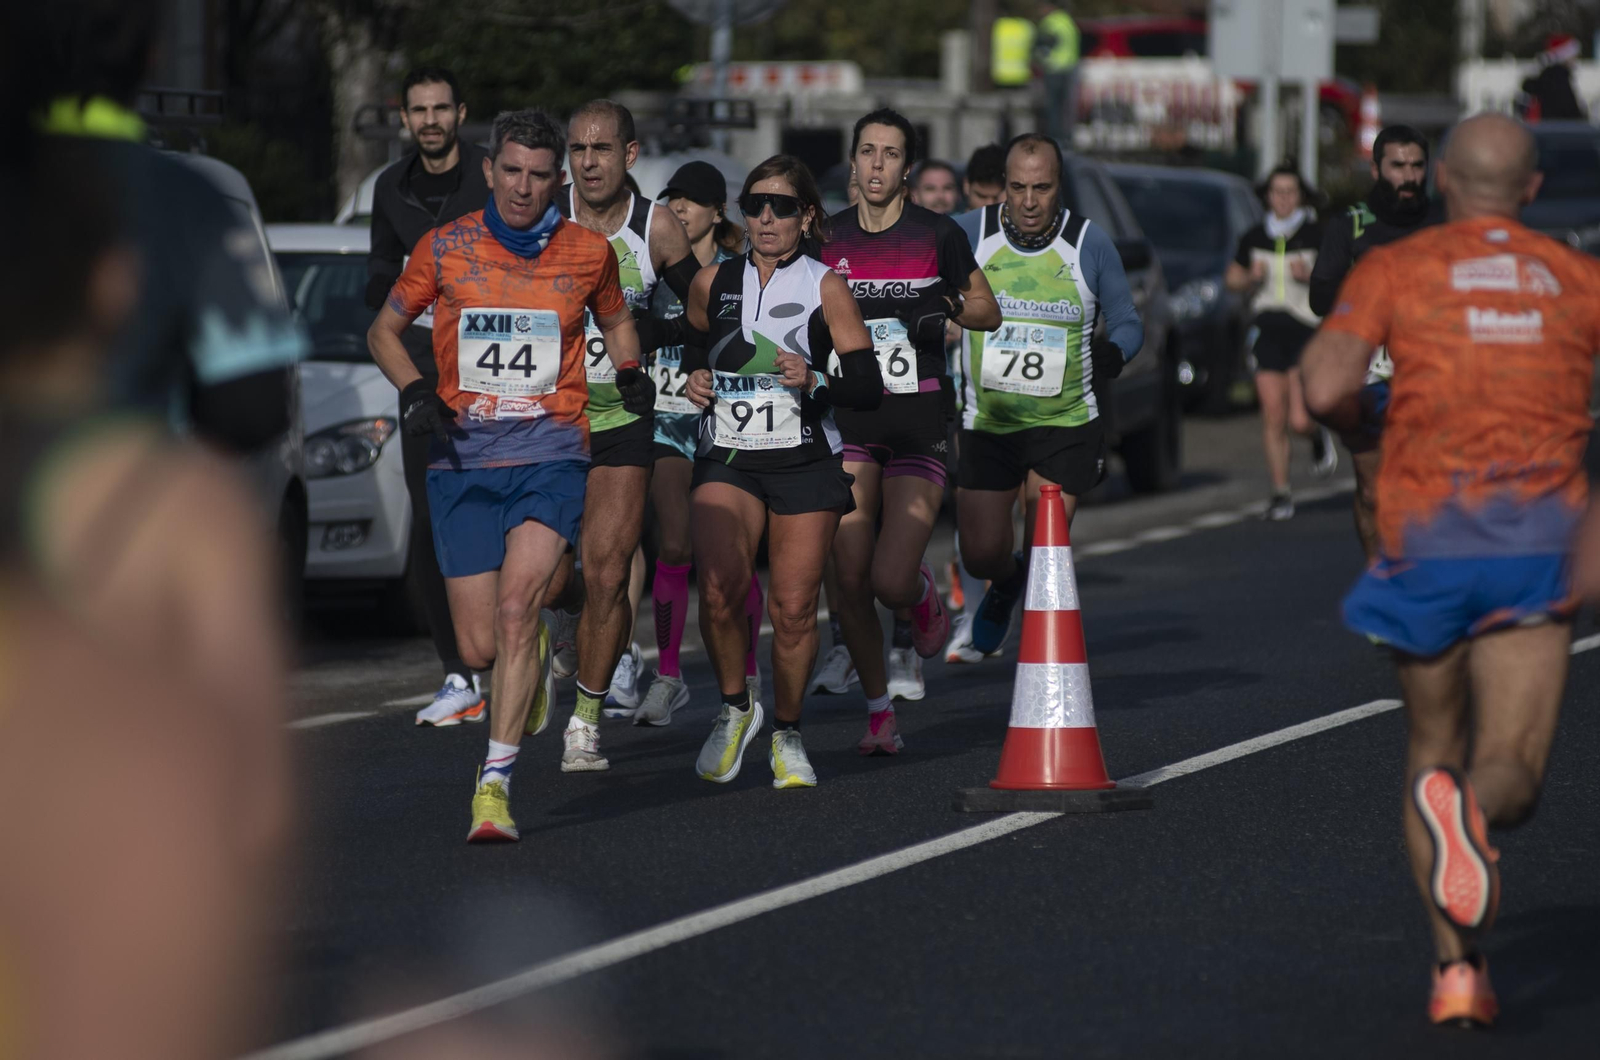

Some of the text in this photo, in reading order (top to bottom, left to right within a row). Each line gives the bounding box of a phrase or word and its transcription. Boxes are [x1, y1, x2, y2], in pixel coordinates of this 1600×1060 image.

[464, 314, 512, 333] XXII
[476, 342, 537, 378] 44
[1000, 349, 1044, 380] 78
[715, 374, 755, 391] XXII
[731, 400, 773, 432] 91
